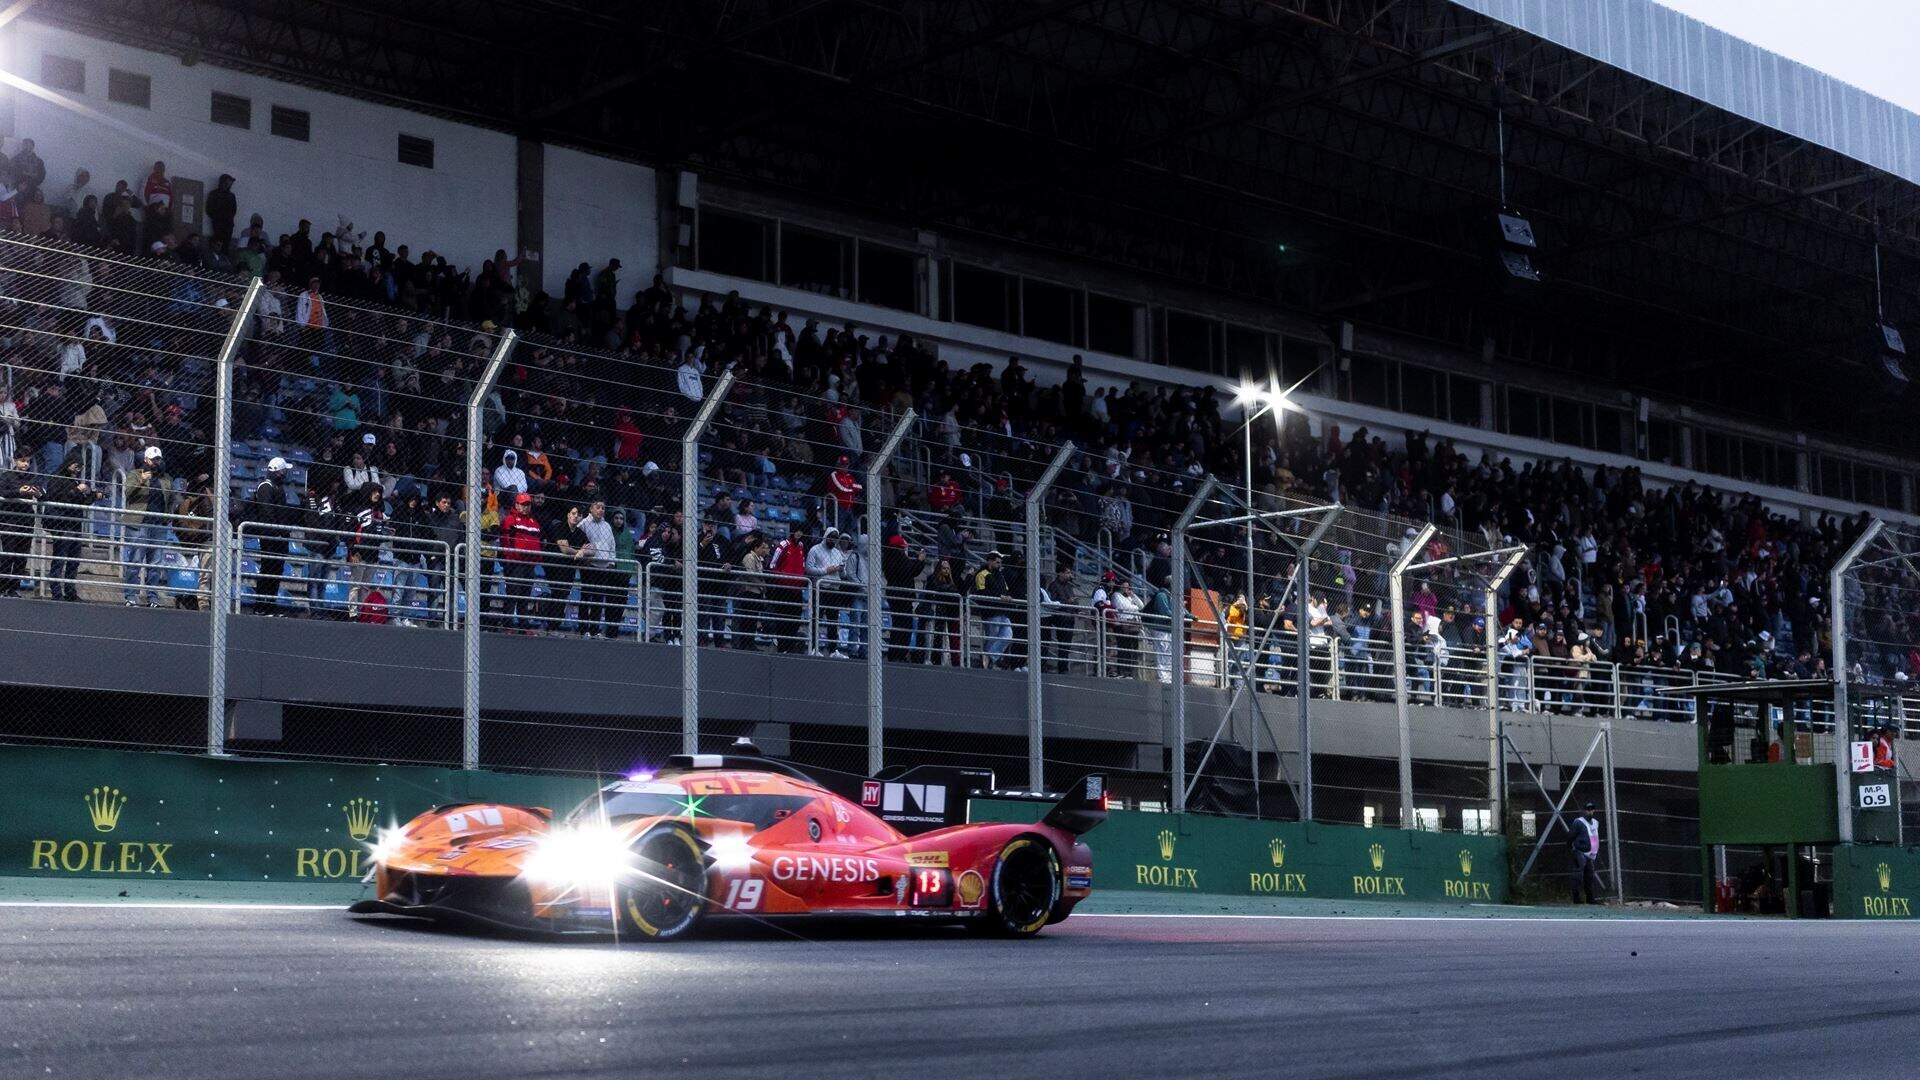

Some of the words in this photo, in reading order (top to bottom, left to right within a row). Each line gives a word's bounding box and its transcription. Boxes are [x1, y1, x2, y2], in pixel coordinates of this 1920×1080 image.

[864, 786, 879, 802] HY
[1862, 794, 1887, 806] 0.9
[1864, 786, 1884, 794] M.P.
[28, 839, 173, 874] ROLEX
[772, 856, 879, 882] GENESIS
[1136, 864, 1198, 888] ROLEX
[919, 870, 941, 893] 13
[1250, 872, 1306, 892] ROLEX
[1353, 876, 1406, 895] ROLEX
[1444, 879, 1491, 900] ROLEX
[724, 879, 765, 910] 19
[1863, 896, 1911, 916] ROLEX
